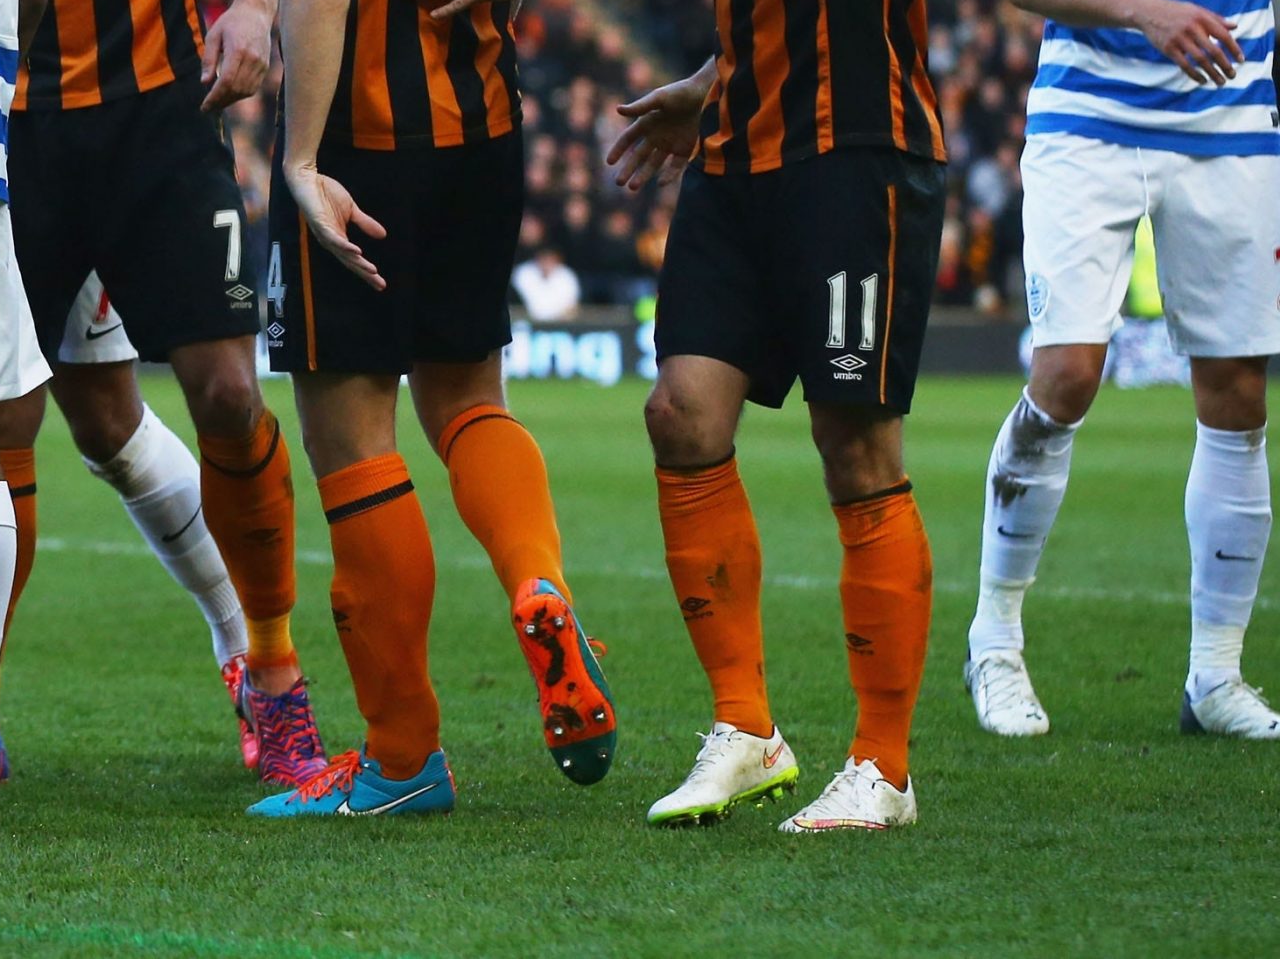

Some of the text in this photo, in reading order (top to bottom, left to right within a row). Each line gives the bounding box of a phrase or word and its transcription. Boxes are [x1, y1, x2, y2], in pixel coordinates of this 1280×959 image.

[213, 209, 242, 281] 7
[267, 241, 287, 318] 4
[826, 271, 879, 351] 11
[833, 372, 862, 381] umbro
